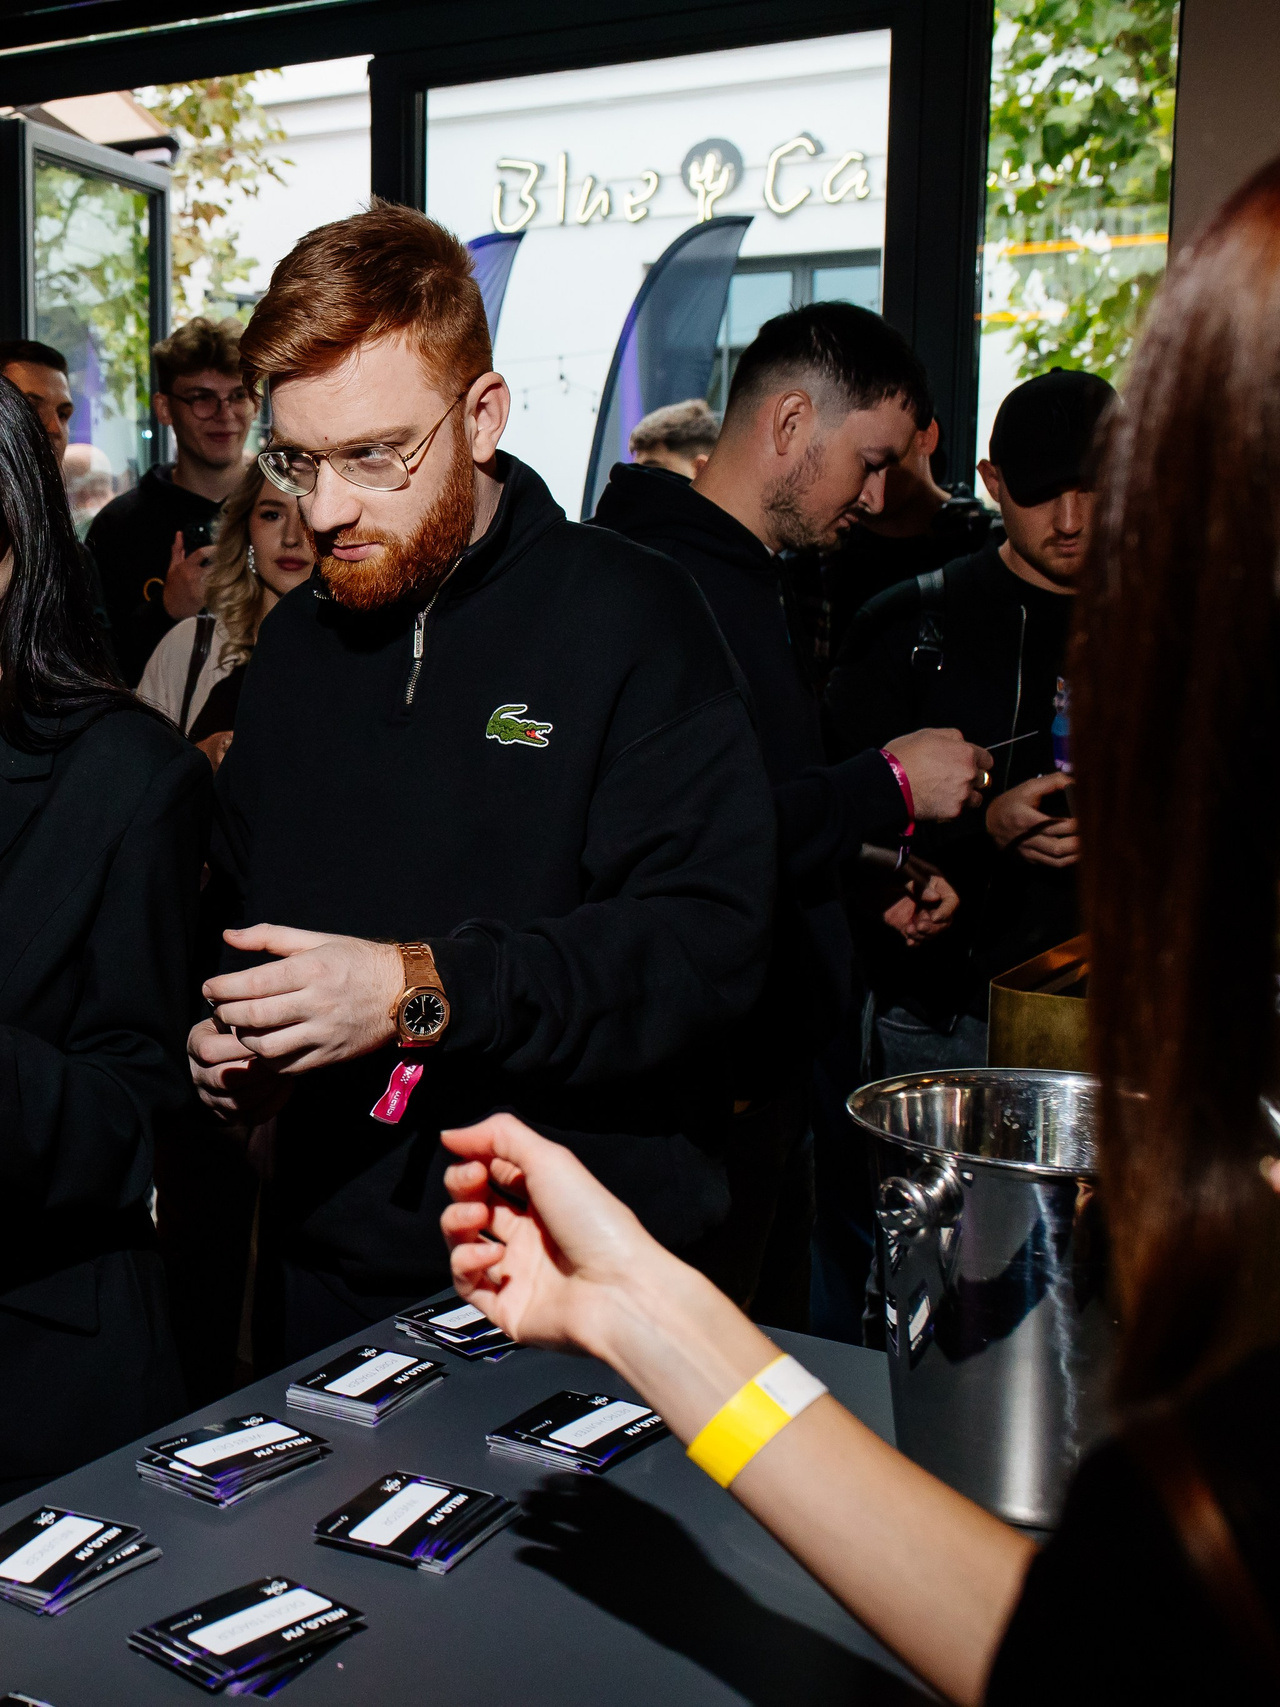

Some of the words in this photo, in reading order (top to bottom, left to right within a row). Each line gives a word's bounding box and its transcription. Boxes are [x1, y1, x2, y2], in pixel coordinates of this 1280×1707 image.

[493, 153, 659, 233] Blue
[404, 1361, 434, 1376] HELLO,
[347, 1371, 377, 1388] TRADER
[636, 1415, 667, 1428] ELLO,
[271, 1436, 312, 1451] HELLO,
[253, 1447, 274, 1458] I'M
[437, 1493, 468, 1514] HELLO,
[87, 1527, 122, 1548] HELLO,
[301, 1608, 348, 1630] HELLO,
[282, 1626, 305, 1641] I'M
